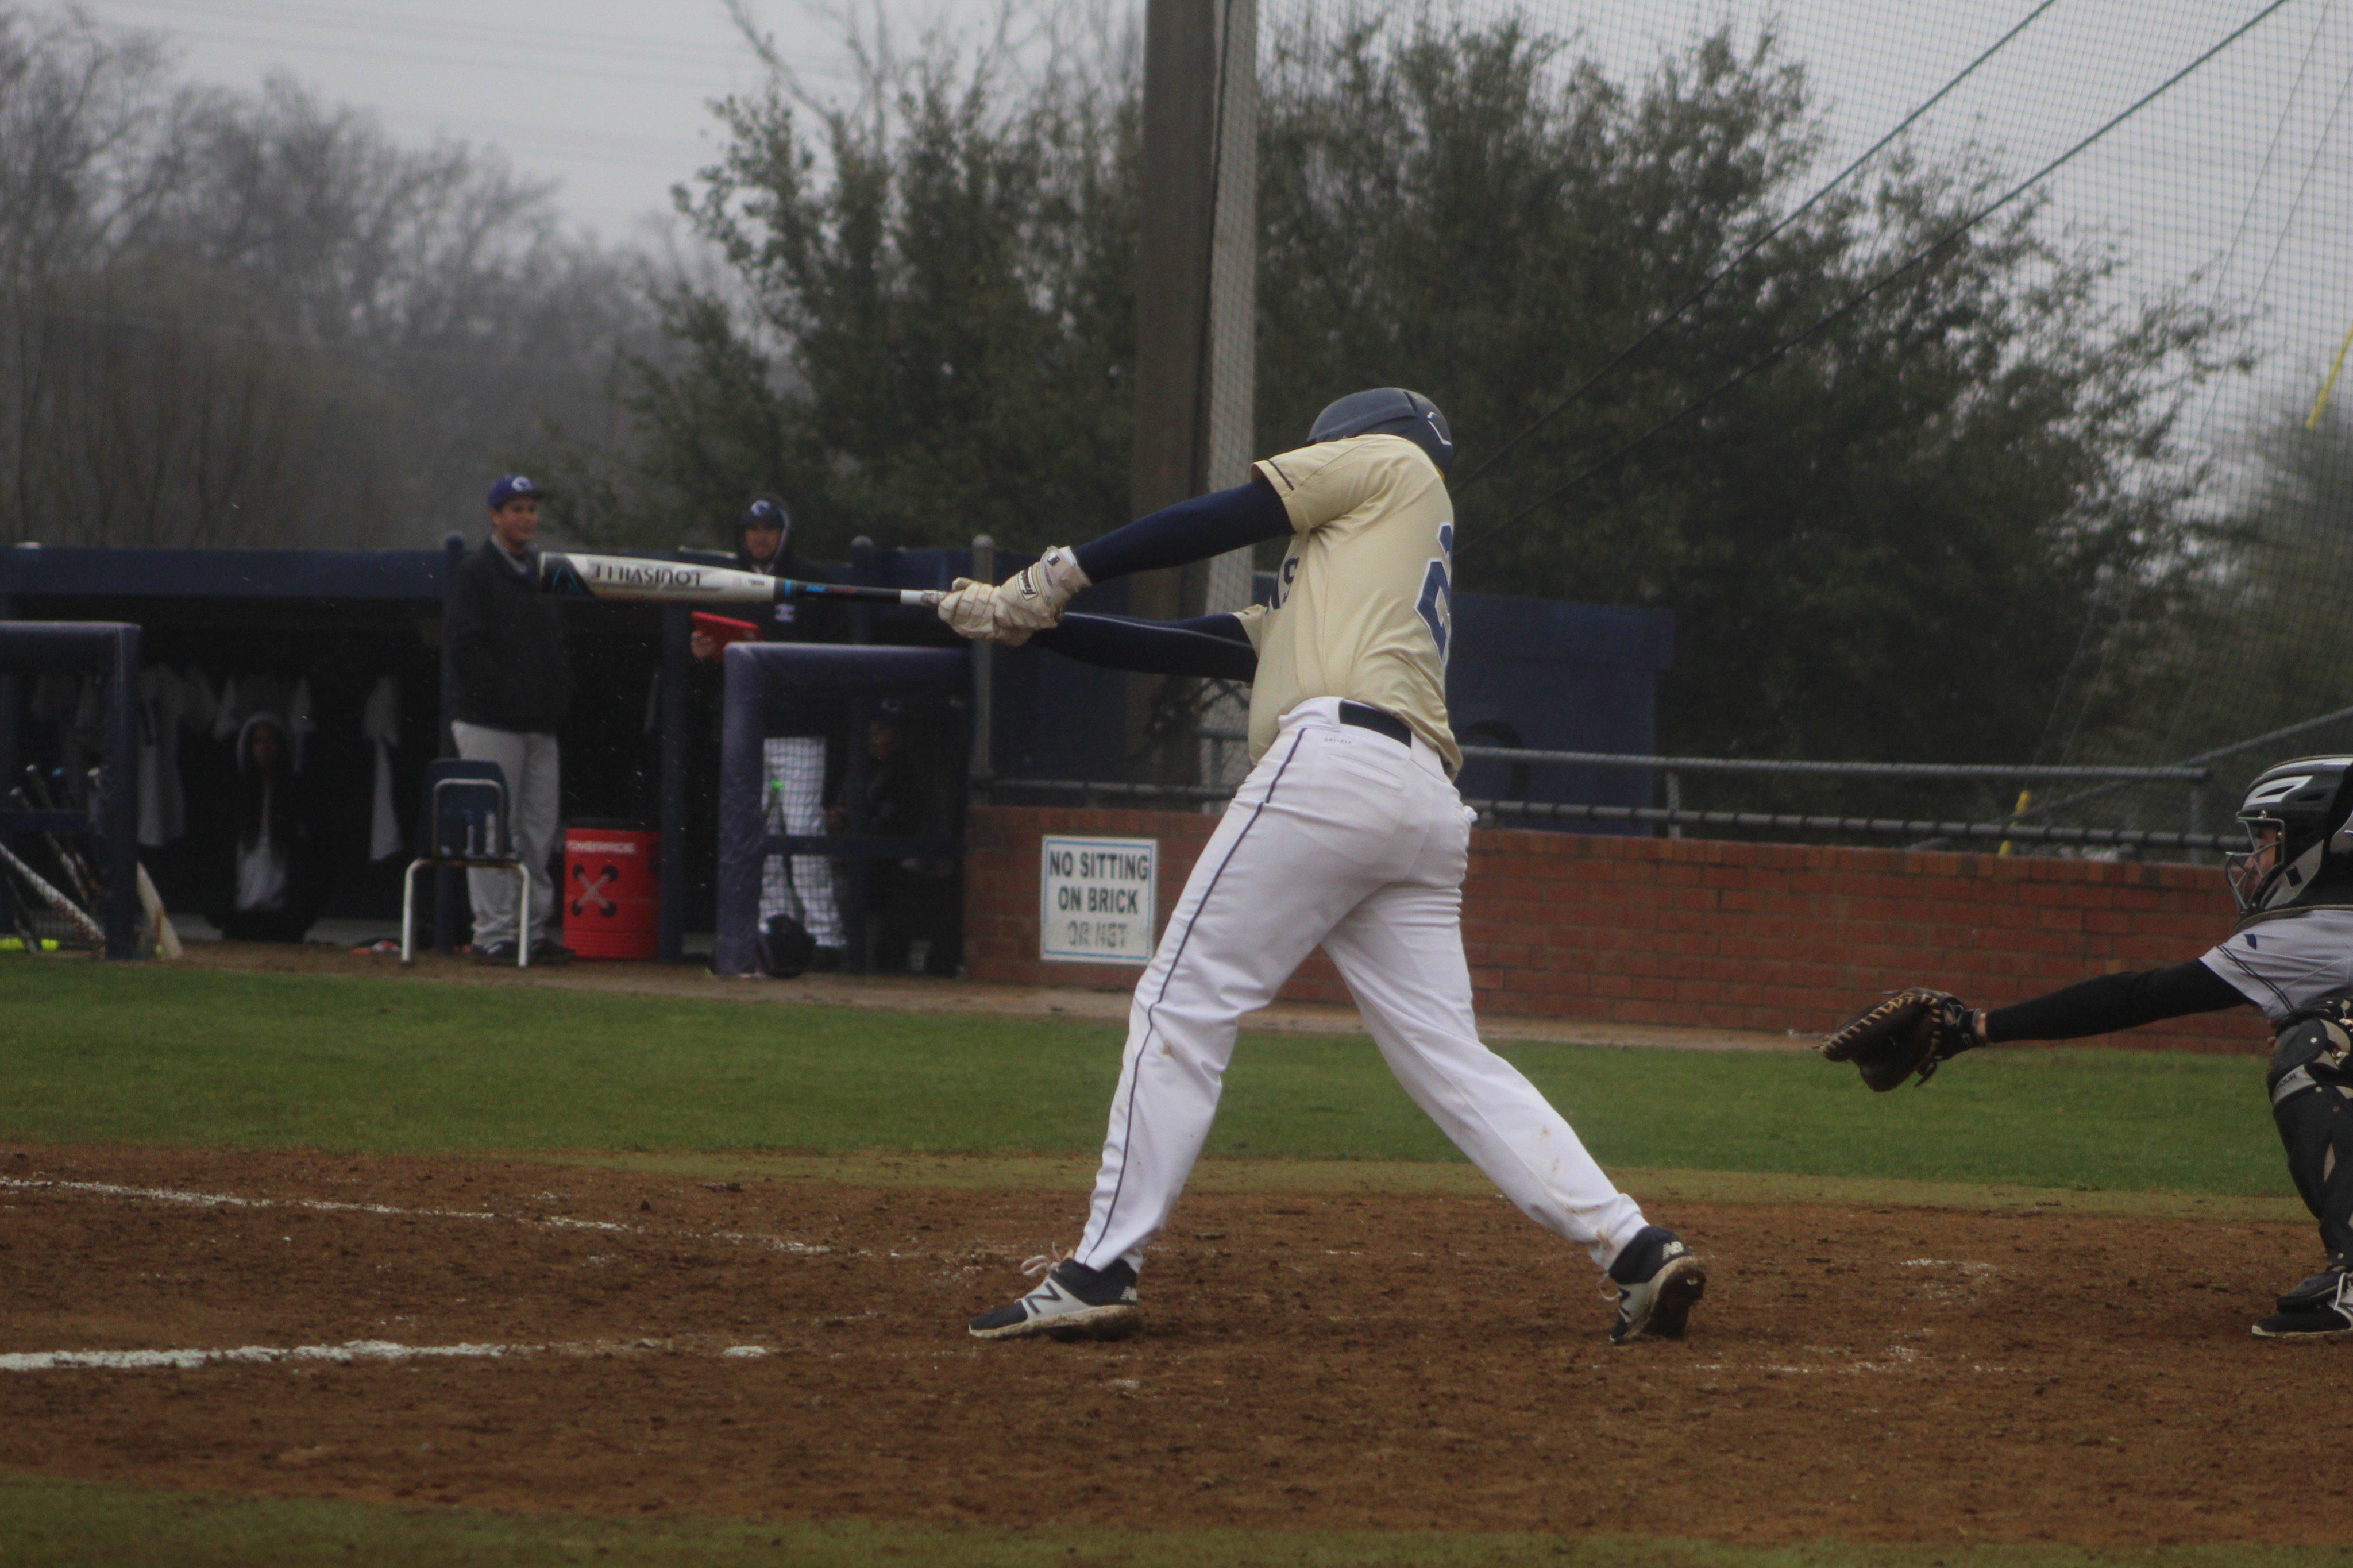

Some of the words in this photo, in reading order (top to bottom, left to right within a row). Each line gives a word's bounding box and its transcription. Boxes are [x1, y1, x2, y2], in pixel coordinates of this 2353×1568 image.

[1049, 851, 1073, 877] NO
[1079, 851, 1148, 881] SITTING
[1058, 886, 1081, 910] ON
[1087, 887, 1138, 914] BRICK
